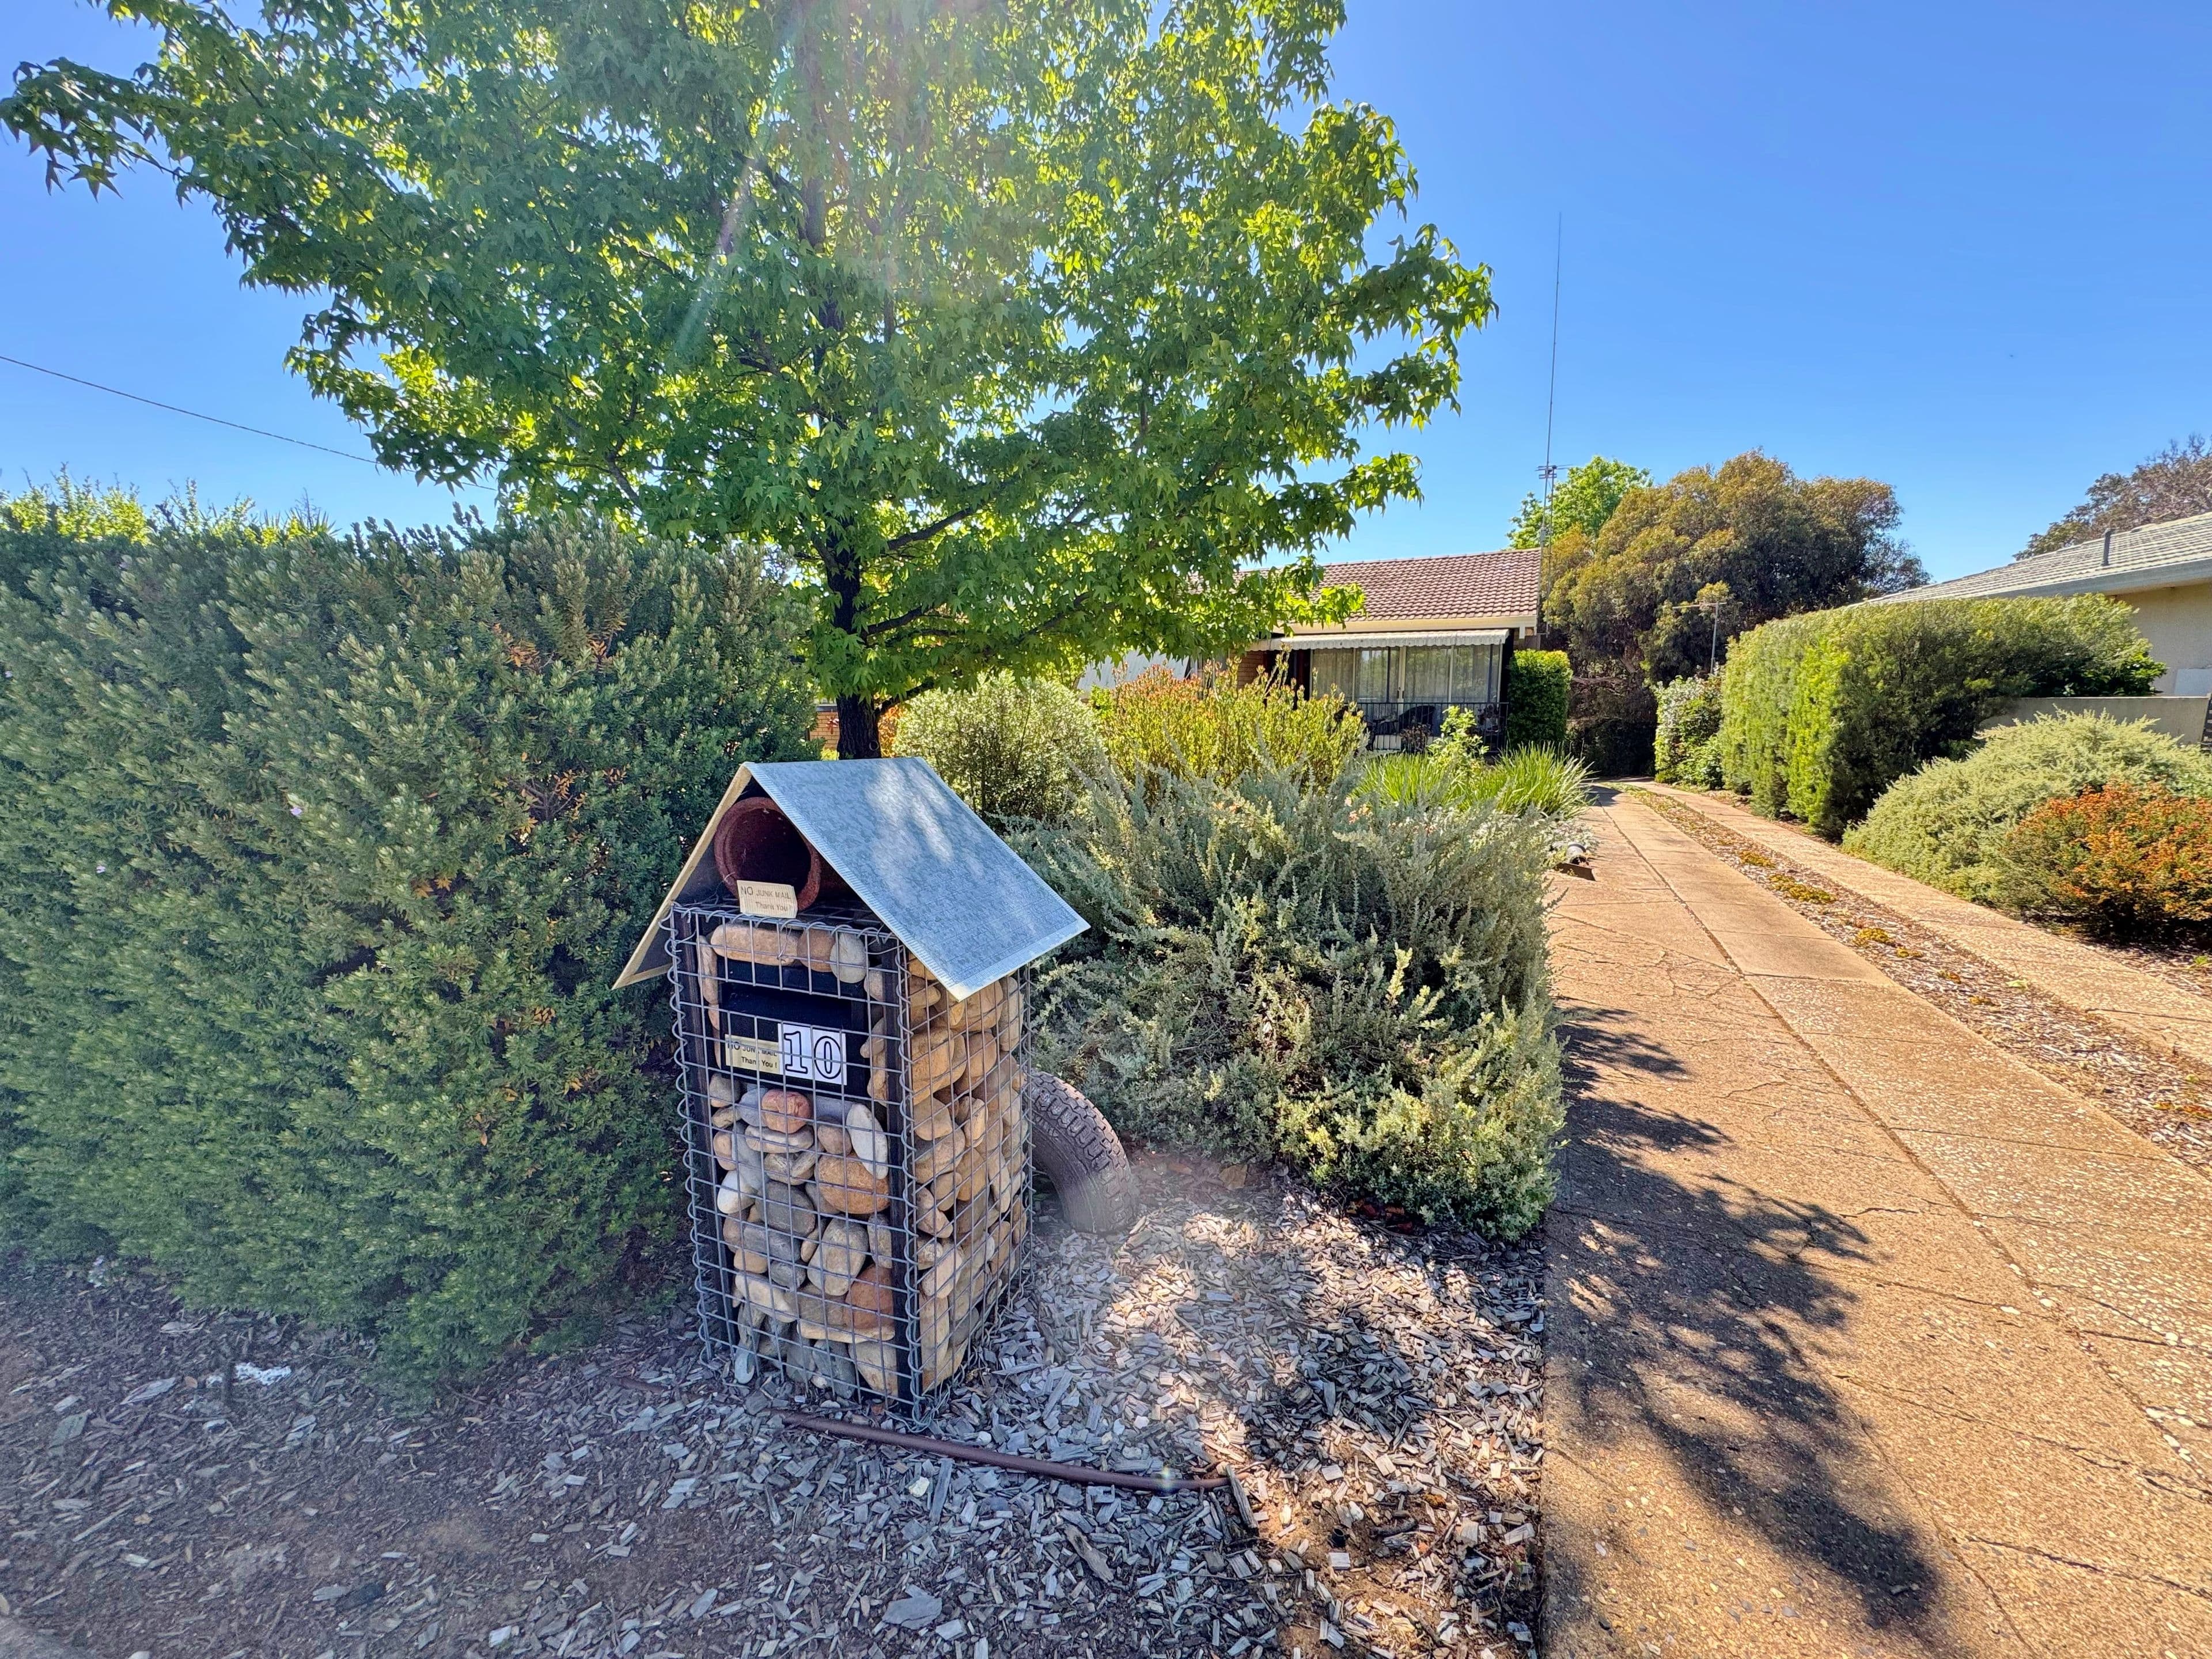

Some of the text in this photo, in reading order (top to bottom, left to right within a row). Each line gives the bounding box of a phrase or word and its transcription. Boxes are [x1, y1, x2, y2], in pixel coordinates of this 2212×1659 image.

[741, 887, 753, 895] NO
[743, 1045, 760, 1054] JUN
[783, 1031, 842, 1080] 10
[741, 1056, 759, 1065] Than
[762, 1060, 773, 1068] You
